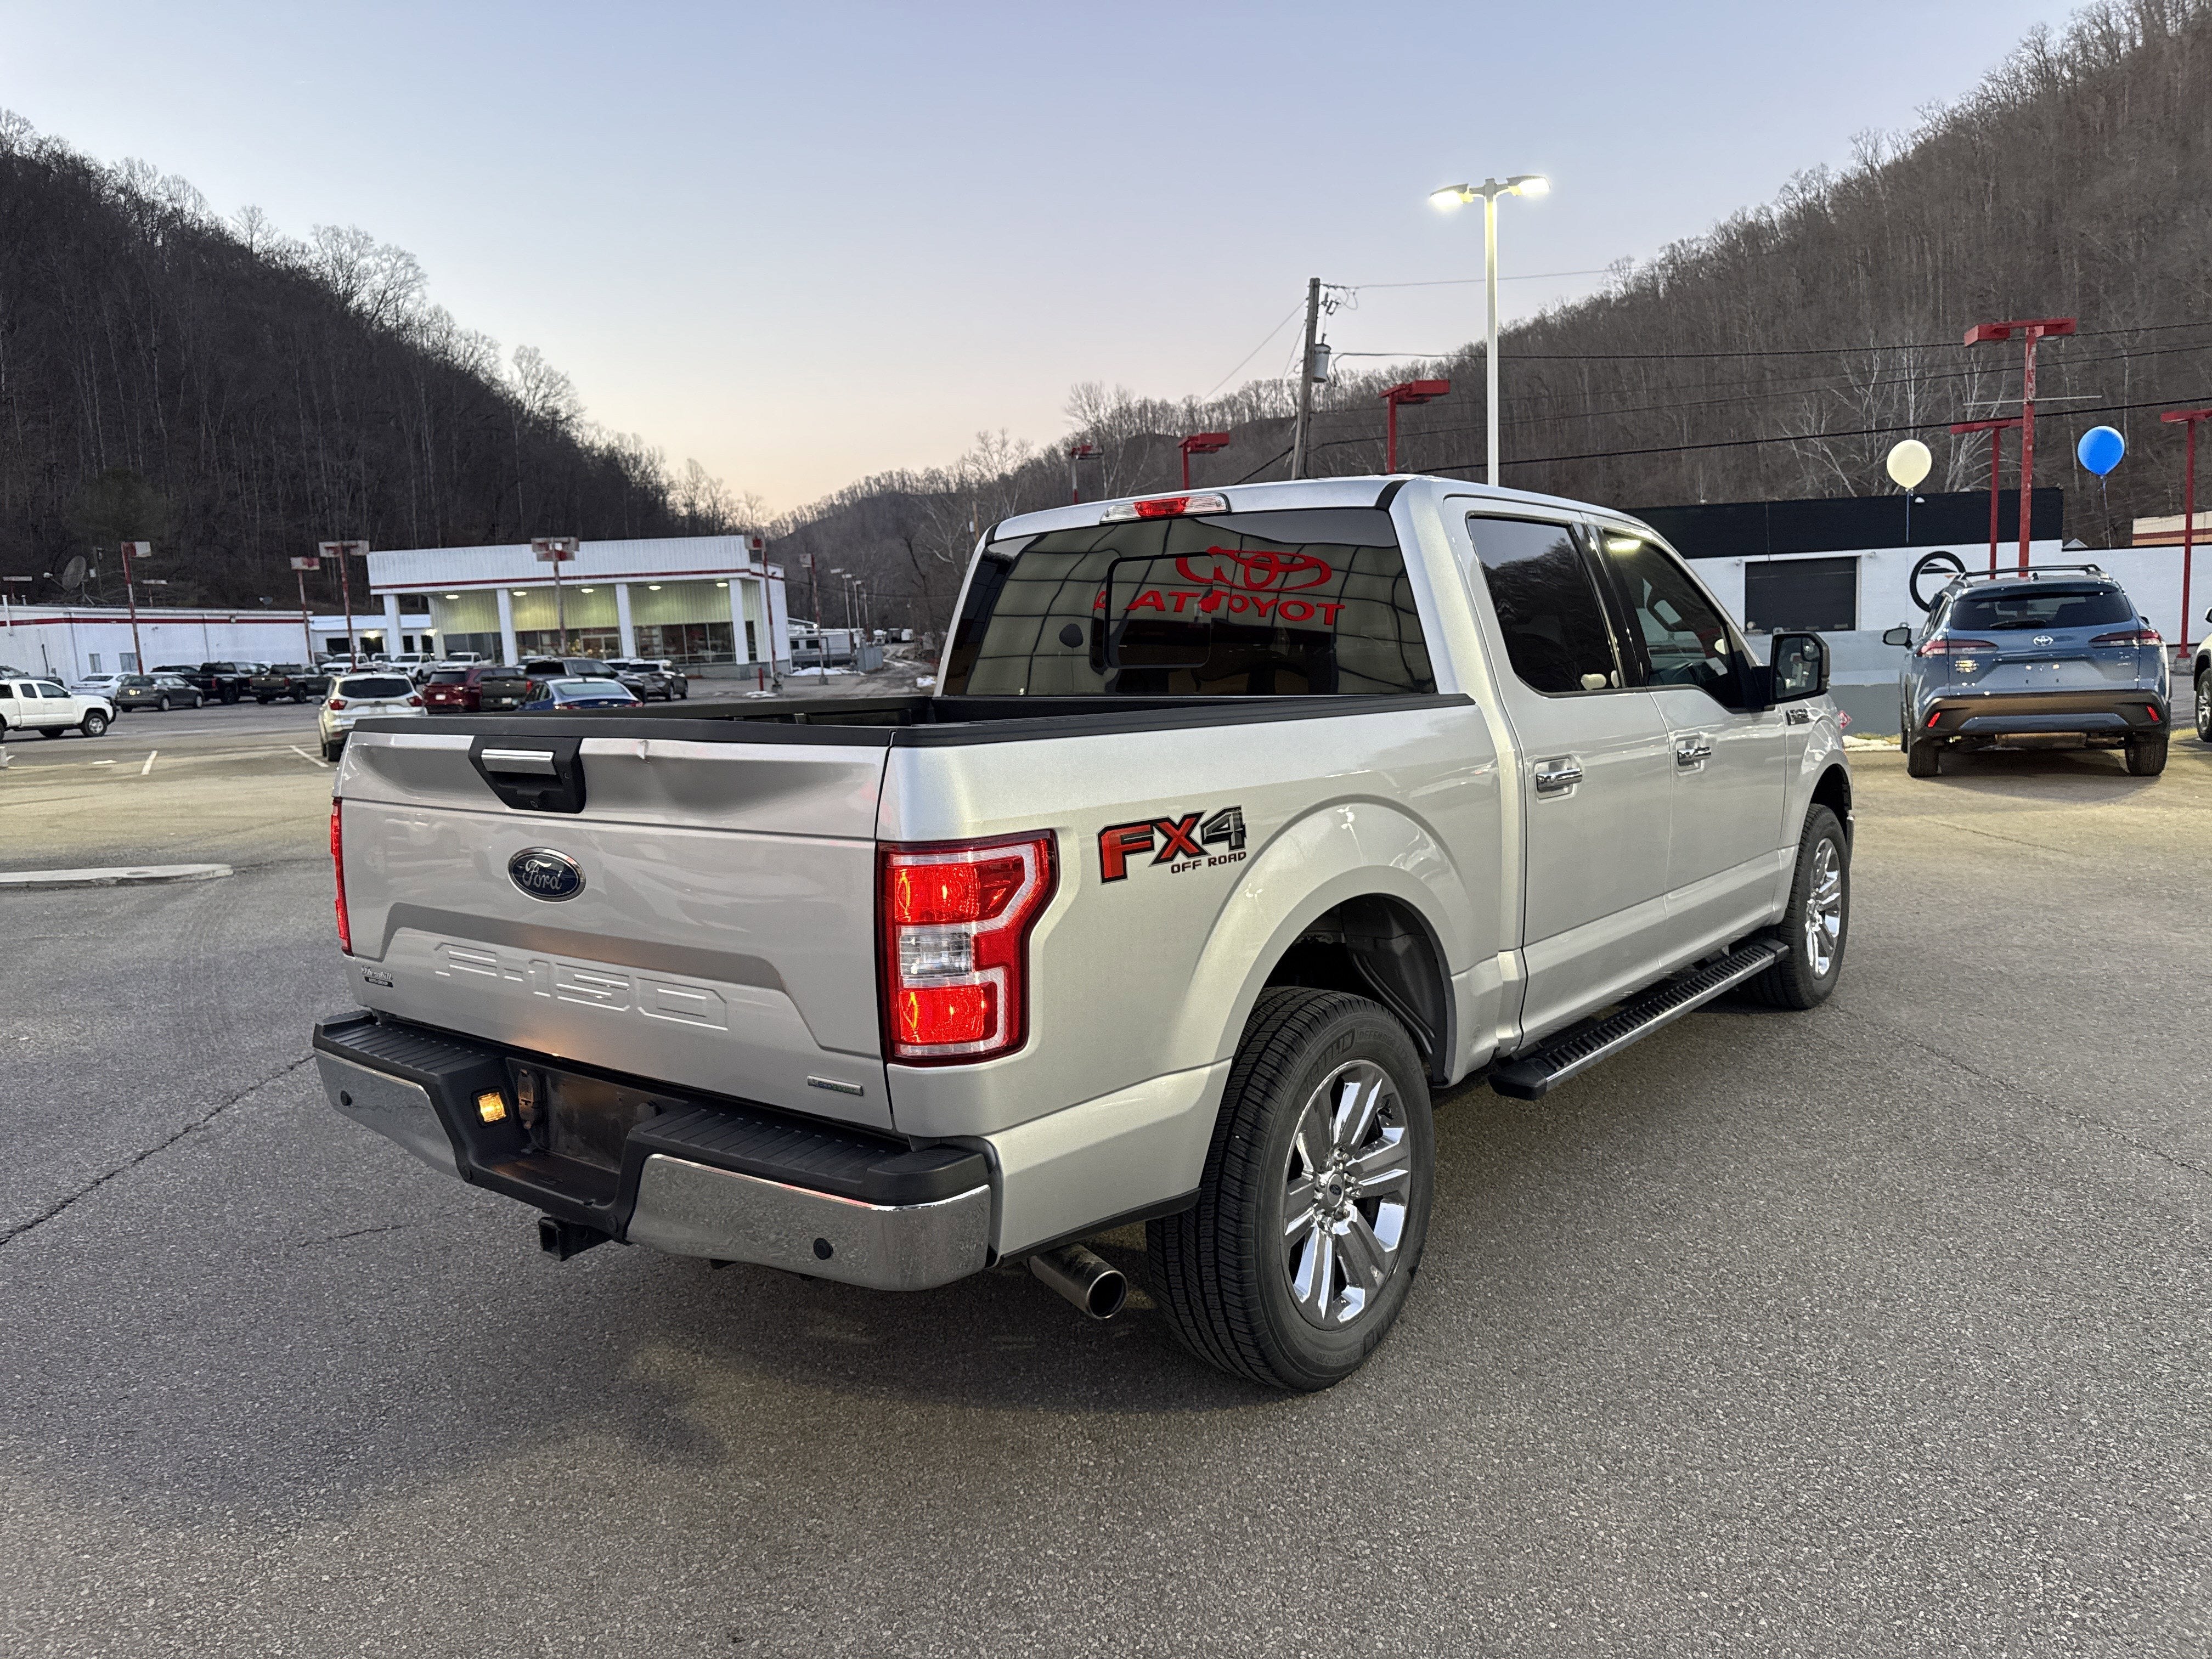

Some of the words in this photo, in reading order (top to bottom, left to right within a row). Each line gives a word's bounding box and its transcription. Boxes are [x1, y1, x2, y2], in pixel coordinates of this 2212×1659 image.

[1097, 805, 1246, 885] FX4
[1170, 859, 1202, 874] OFF
[1207, 851, 1247, 867] ROAD
[522, 859, 562, 890] Ford
[434, 942, 728, 1030] F-150
